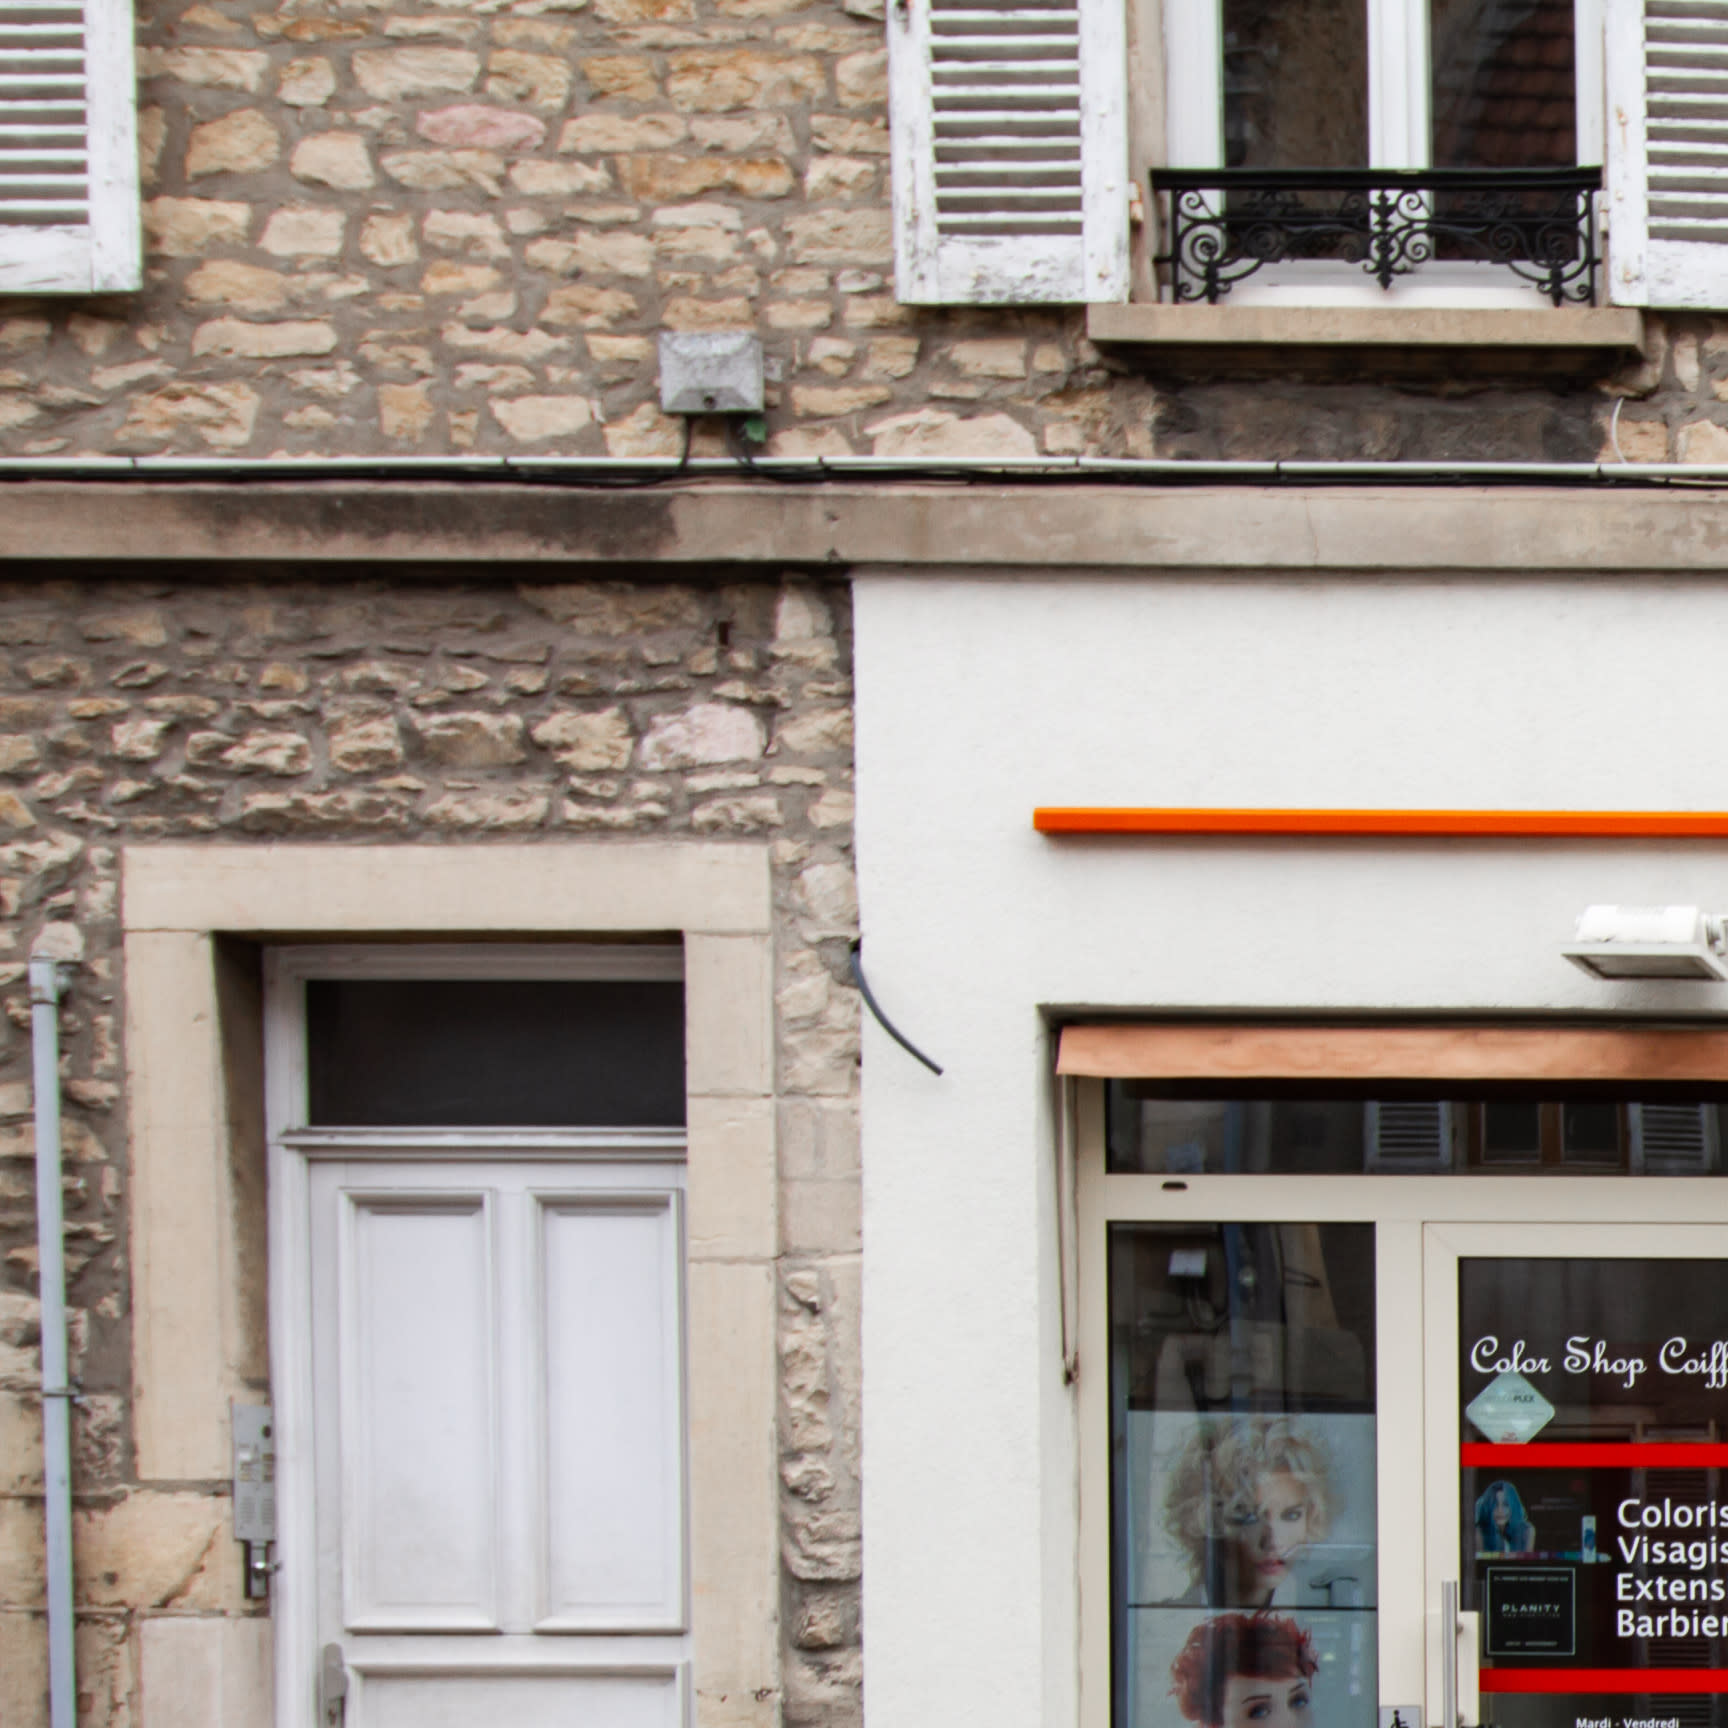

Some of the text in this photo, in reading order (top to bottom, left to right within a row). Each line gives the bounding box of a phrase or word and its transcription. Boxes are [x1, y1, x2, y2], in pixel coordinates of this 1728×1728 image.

[1470, 1335, 1551, 1375] Color
[1563, 1336, 1647, 1389] Shop
[1501, 1603, 1561, 1614] PLANITY
